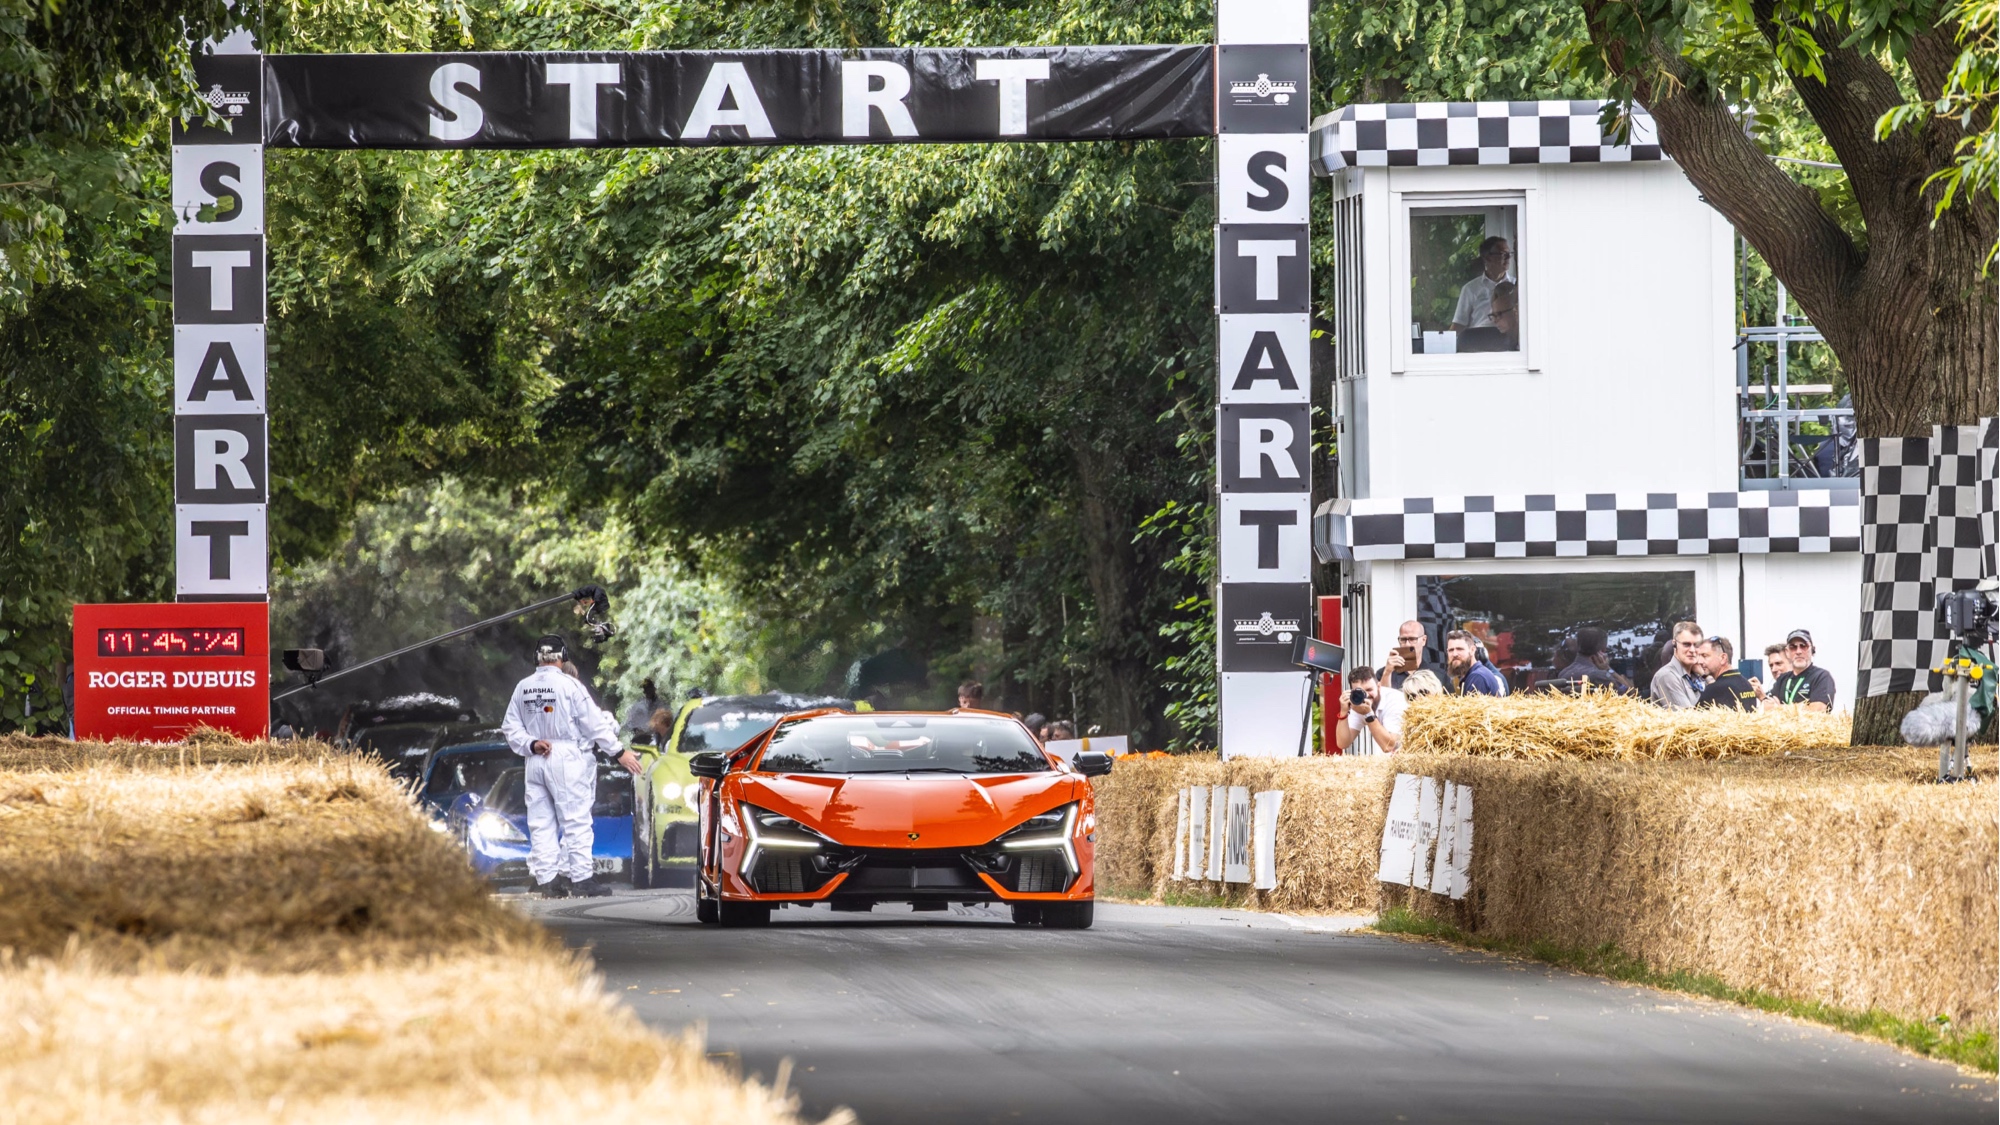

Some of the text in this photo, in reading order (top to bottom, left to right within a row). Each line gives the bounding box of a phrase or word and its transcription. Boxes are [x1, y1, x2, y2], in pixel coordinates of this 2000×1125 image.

[428, 58, 1051, 142] START
[186, 161, 255, 581] START
[1231, 150, 1300, 570] START
[88, 670, 256, 688] ROGER DUBUIS
[523, 687, 555, 695] MARSHAL
[107, 706, 236, 715] OFFICIAL TIMING PARTNER
